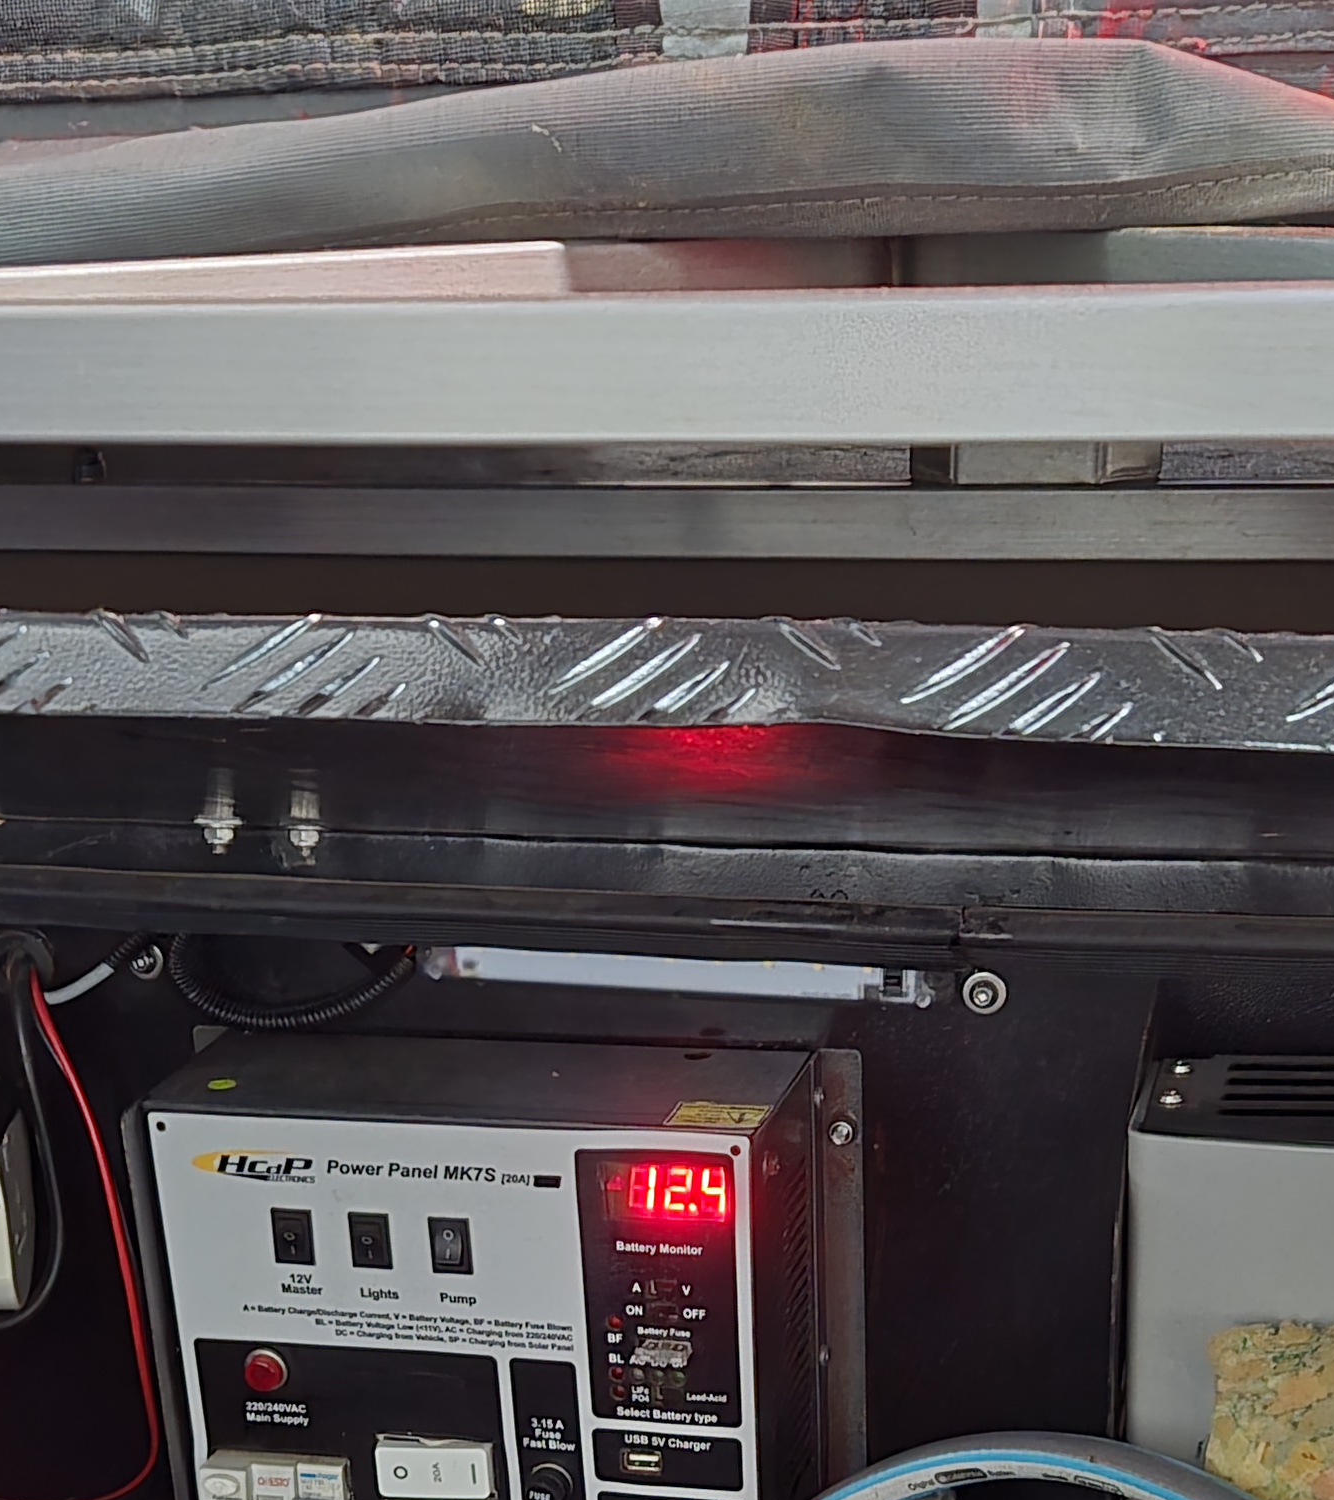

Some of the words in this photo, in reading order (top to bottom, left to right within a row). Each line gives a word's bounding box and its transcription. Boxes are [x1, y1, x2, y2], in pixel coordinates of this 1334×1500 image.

[326, 1160, 384, 1178] Power
[387, 1163, 438, 1180] Panel
[444, 1165, 496, 1183] MK7S
[501, 1173, 530, 1186] [20A]
[646, 1166, 726, 1214] 12.4
[616, 1240, 656, 1255] Battery
[659, 1243, 703, 1256] Monitor
[289, 1273, 312, 1284] 12V
[281, 1284, 323, 1296] Master
[360, 1287, 399, 1301] Lights
[632, 1282, 641, 1293] A
[681, 1285, 691, 1296] V
[440, 1292, 477, 1307] Pump
[625, 1305, 643, 1316] ON
[683, 1308, 706, 1320] OFF
[257, 1305, 286, 1315] Battery
[408, 1314, 438, 1324] Battery
[494, 1319, 523, 1330] Battery
[525, 1321, 545, 1330] Fuse
[335, 1320, 364, 1329] Battery
[365, 1321, 395, 1331] Voltage
[466, 1327, 504, 1338] Charging
[505, 1330, 524, 1339] from
[637, 1326, 668, 1338] Battery
[669, 1327, 691, 1338] Fuse
[356, 1330, 393, 1340] Charging
[468, 1337, 506, 1348] Charging
[507, 1340, 526, 1349] from
[528, 1341, 549, 1350] Solar
[551, 1343, 574, 1352] Panel
[607, 1333, 623, 1343] BF
[608, 1353, 625, 1364] BL
[686, 1392, 727, 1403] Lead-Acid
[245, 1401, 307, 1414] 220/240VAC
[246, 1412, 272, 1423] Main
[273, 1413, 309, 1427] Supply
[616, 1406, 651, 1419] Select
[652, 1409, 692, 1423] Battery
[694, 1411, 718, 1425] type
[531, 1417, 554, 1429] 3.15
[554, 1419, 565, 1430] A
[534, 1429, 562, 1440] Fuse
[522, 1437, 547, 1450] Fast
[548, 1439, 576, 1452] Blow
[624, 1433, 648, 1445] USB
[651, 1436, 665, 1448] 5V
[668, 1438, 712, 1452] Charger
[431, 1461, 442, 1483] 20A
